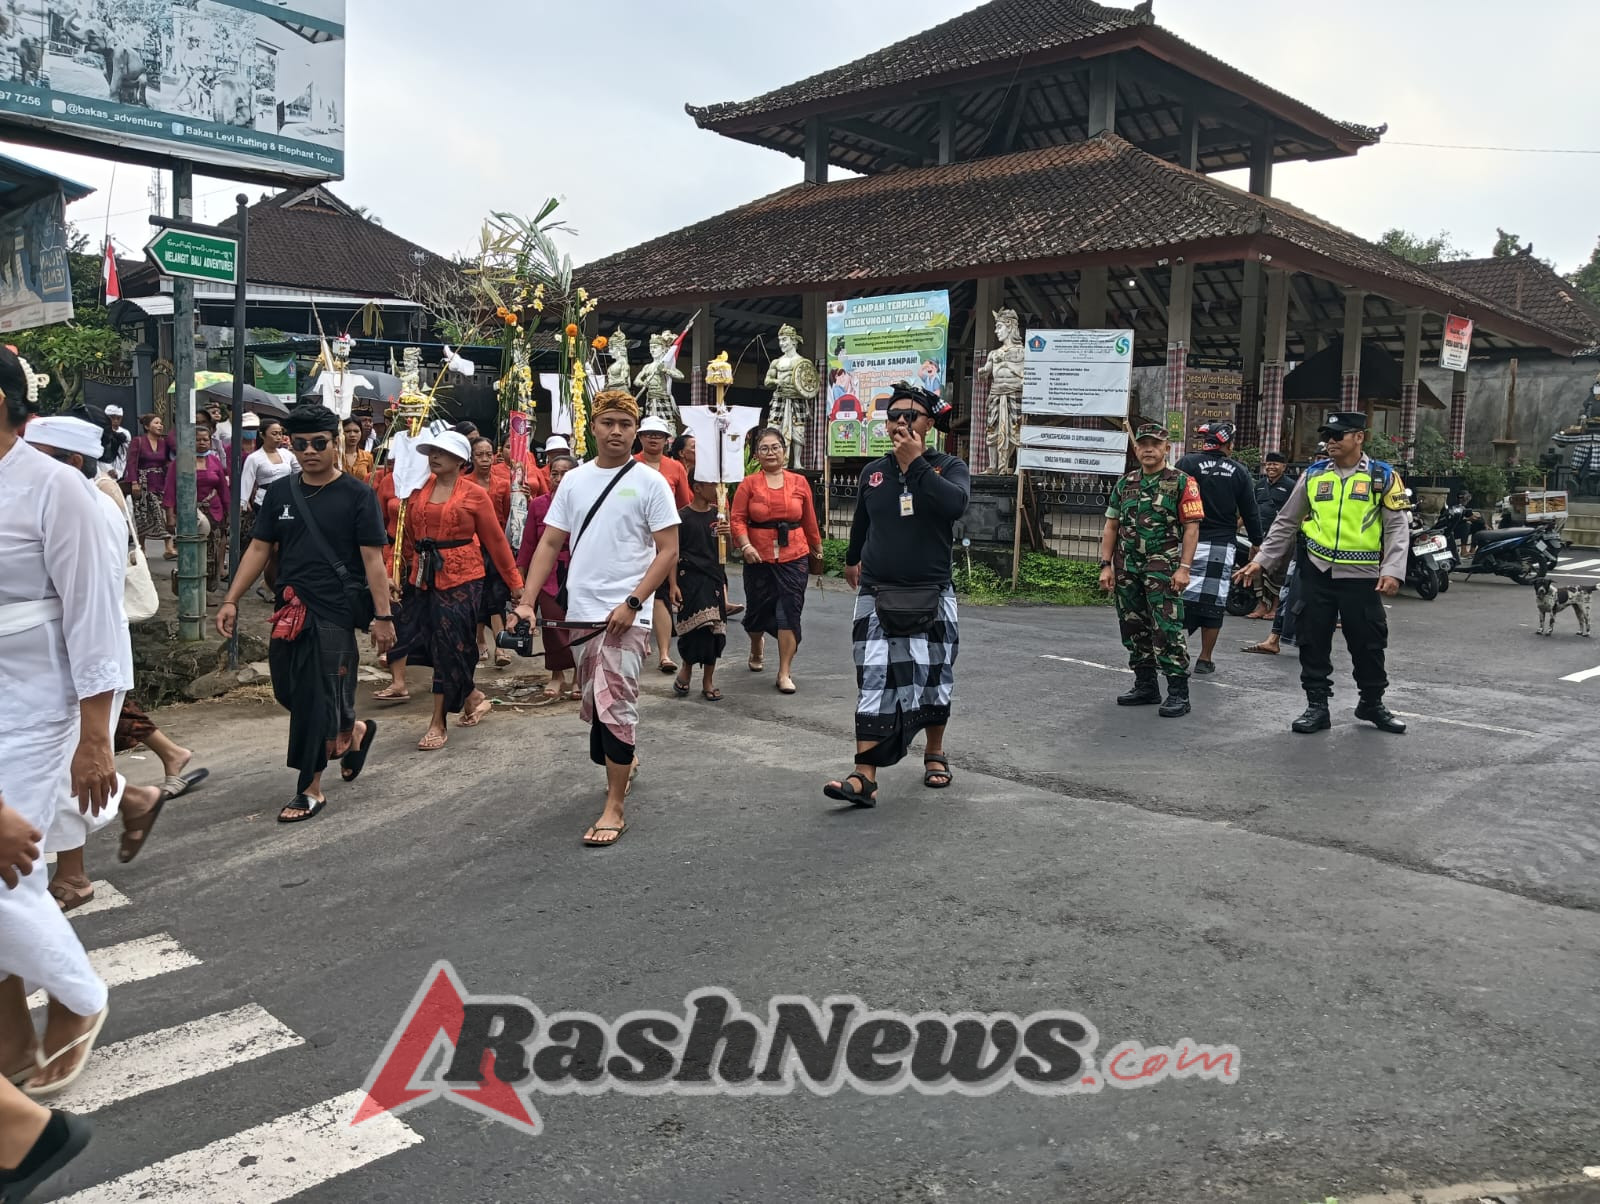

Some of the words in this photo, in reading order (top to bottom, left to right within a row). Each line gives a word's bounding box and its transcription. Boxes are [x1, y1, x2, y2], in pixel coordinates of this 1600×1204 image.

[15, 93, 41, 106] 7256
[67, 103, 163, 129] @bakas_adventure
[186, 125, 213, 138] Bakas
[237, 136, 268, 150] Rafting
[279, 144, 314, 158] Elephant
[316, 152, 334, 164] Tour
[164, 250, 189, 265] MELANGIT
[191, 254, 202, 267] BALI
[203, 257, 234, 272] ADVENTURES
[852, 302, 885, 314] SAMPAH
[887, 298, 925, 311] TERPILAH
[844, 313, 892, 328] LINGKUNGAN
[894, 311, 933, 323] TERJAGA!
[852, 360, 865, 368] AYO
[866, 359, 886, 367] PILAH
[887, 356, 918, 366] SAMPAH!
[1186, 373, 1201, 383] Desa
[1201, 373, 1224, 384] Wisata
[1194, 390, 1216, 400] Sapta
[1201, 408, 1223, 417] Aman
